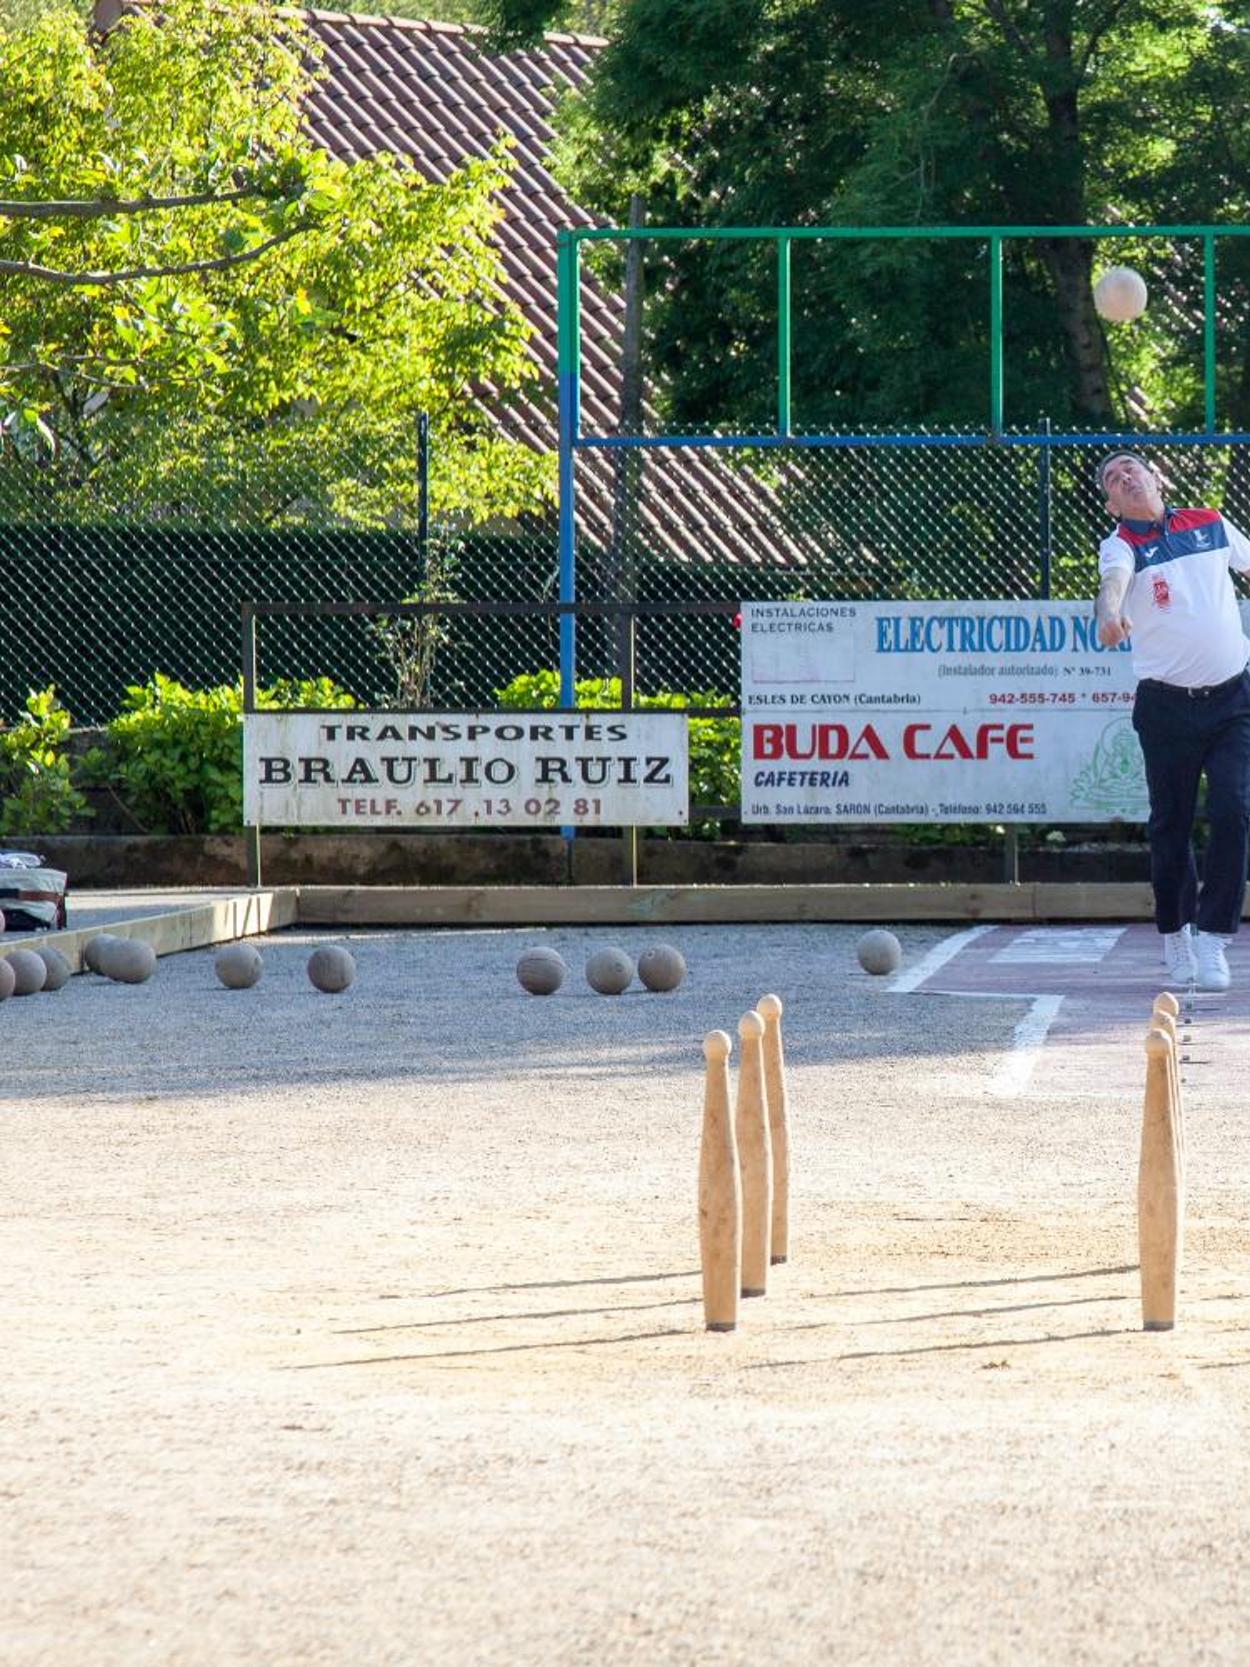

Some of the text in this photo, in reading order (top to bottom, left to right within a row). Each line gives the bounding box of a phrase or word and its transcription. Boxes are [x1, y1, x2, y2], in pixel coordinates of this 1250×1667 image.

[751, 608, 857, 618] INSTALACIONES
[751, 622, 835, 632] ELECTRICAS
[875, 616, 1067, 653] ELECTRICIDAD
[938, 664, 995, 678] (Instalador
[748, 694, 786, 705] ESLES
[790, 694, 807, 704] DE
[855, 693, 921, 706] (Cantabria)
[989, 693, 1076, 704] 942-555-745
[319, 724, 629, 741] TRANSPORTES
[752, 724, 1035, 760] BUDA CAFE
[258, 756, 673, 785] BRAULIO RUIZ
[754, 771, 851, 787] CAFETERIA
[337, 799, 602, 816] TELF. 617 13 02 81
[775, 803, 794, 814] San
[985, 804, 1004, 815] 942
[1028, 804, 1047, 815] 555
